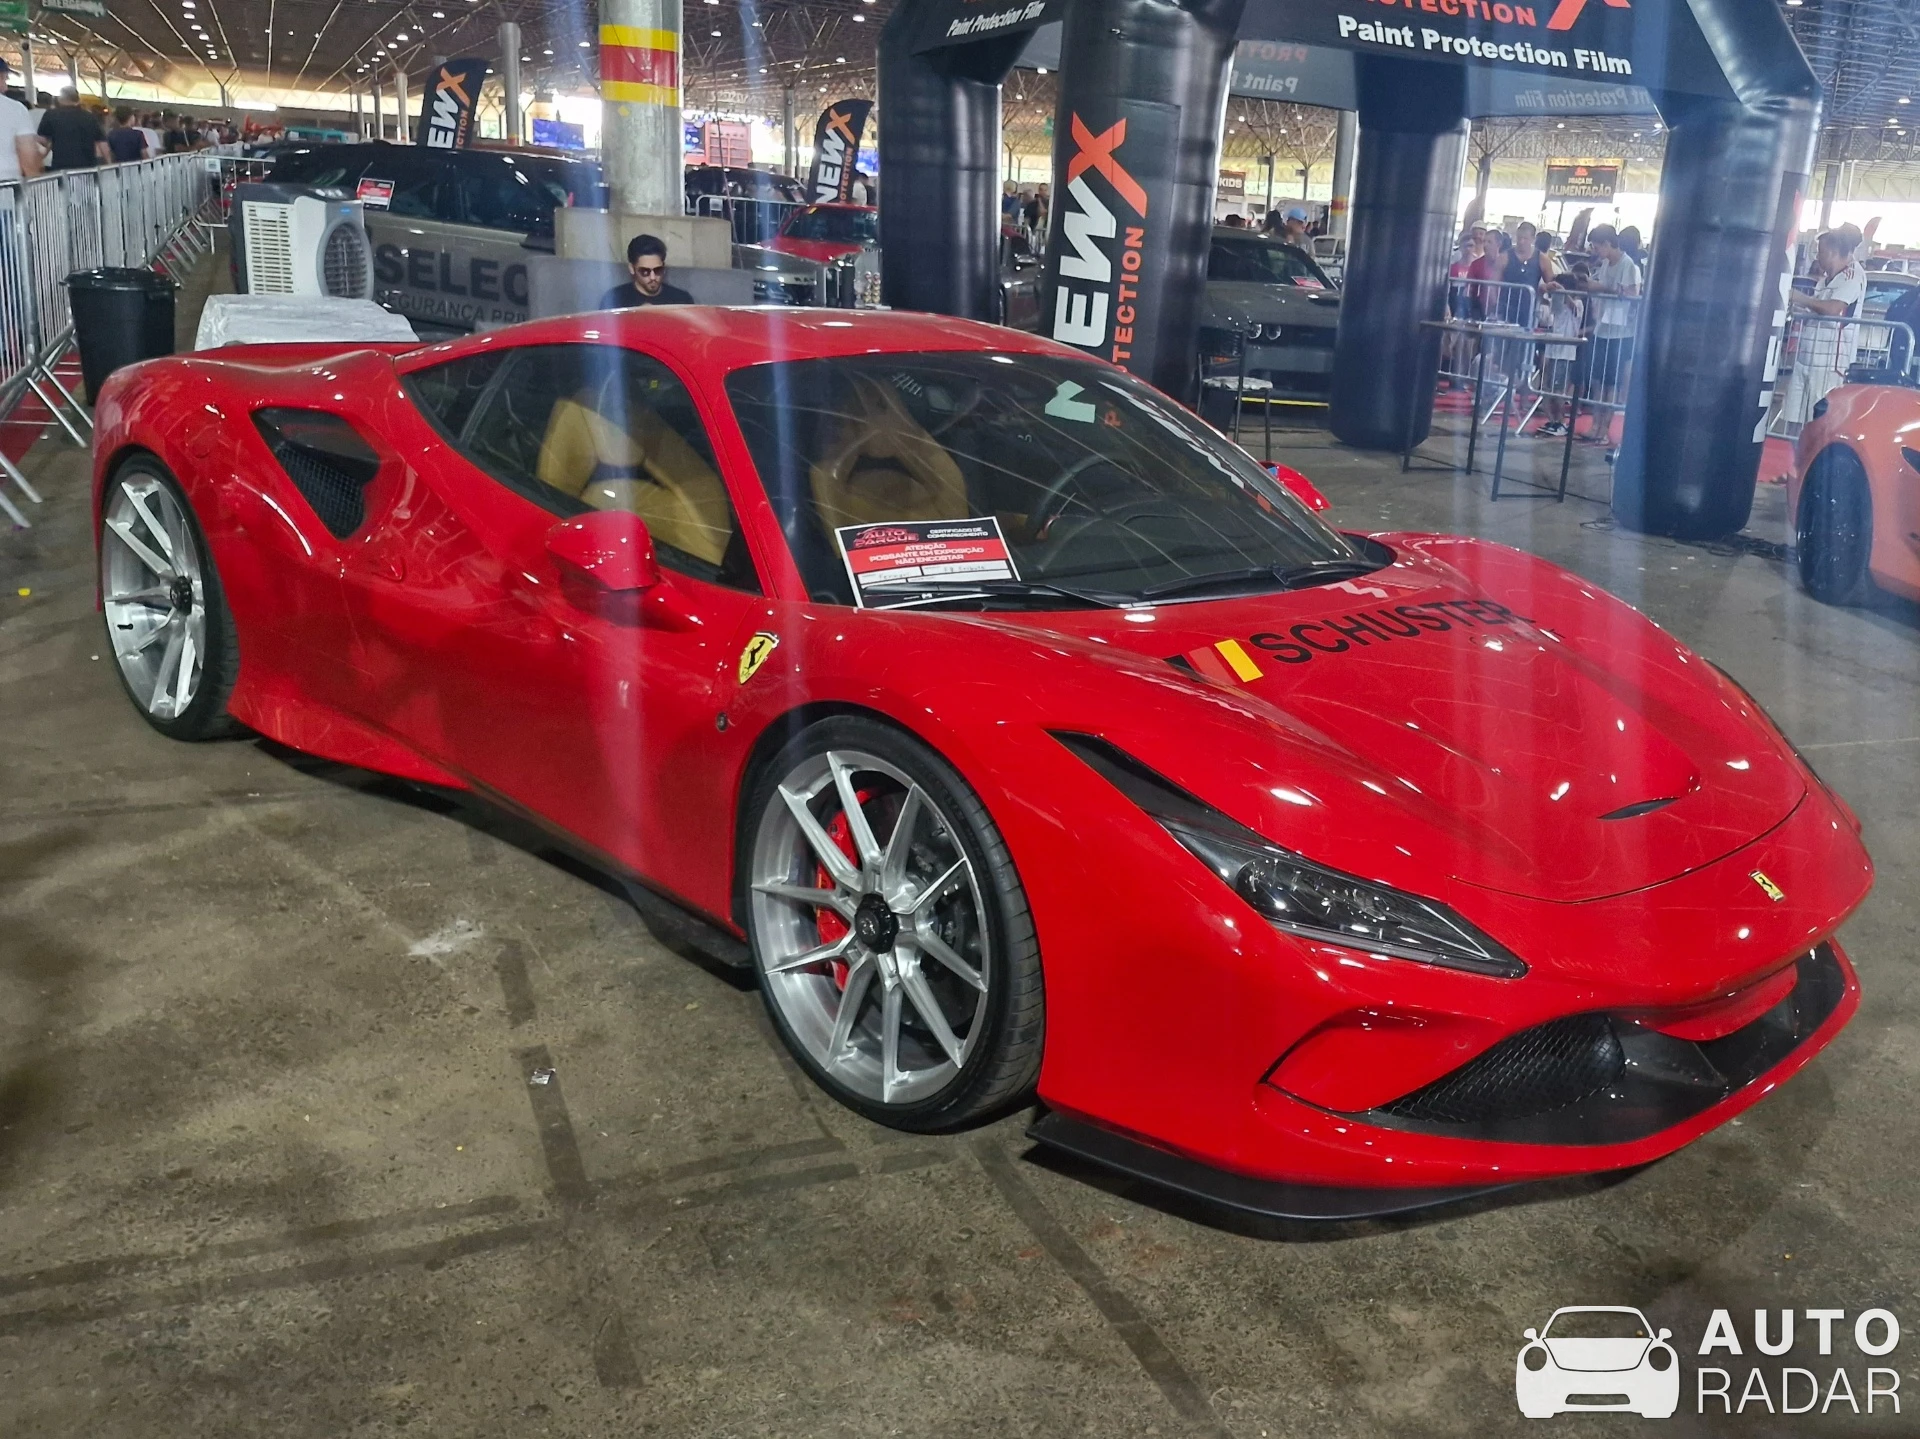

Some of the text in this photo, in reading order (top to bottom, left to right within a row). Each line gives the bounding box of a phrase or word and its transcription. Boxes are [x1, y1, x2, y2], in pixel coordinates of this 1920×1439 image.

[946, 0, 1045, 37] Paint Protection Film
[1338, 15, 1632, 75] Paint Protection Film
[427, 67, 471, 149] EWX
[839, 147, 854, 203] OTECTION
[1219, 177, 1242, 189] KIDS
[1548, 184, 1612, 198] ALIMENTAÇÃO
[854, 533, 919, 548] PARQUE
[862, 529, 906, 540] AUTO
[869, 547, 985, 563] POSSANTE EM EXPOSIÇÃO
[904, 543, 947, 552] ATENÇÃO
[895, 554, 964, 566] NÃO ENCOSTAR
[1249, 598, 1536, 664] SCHUSTER
